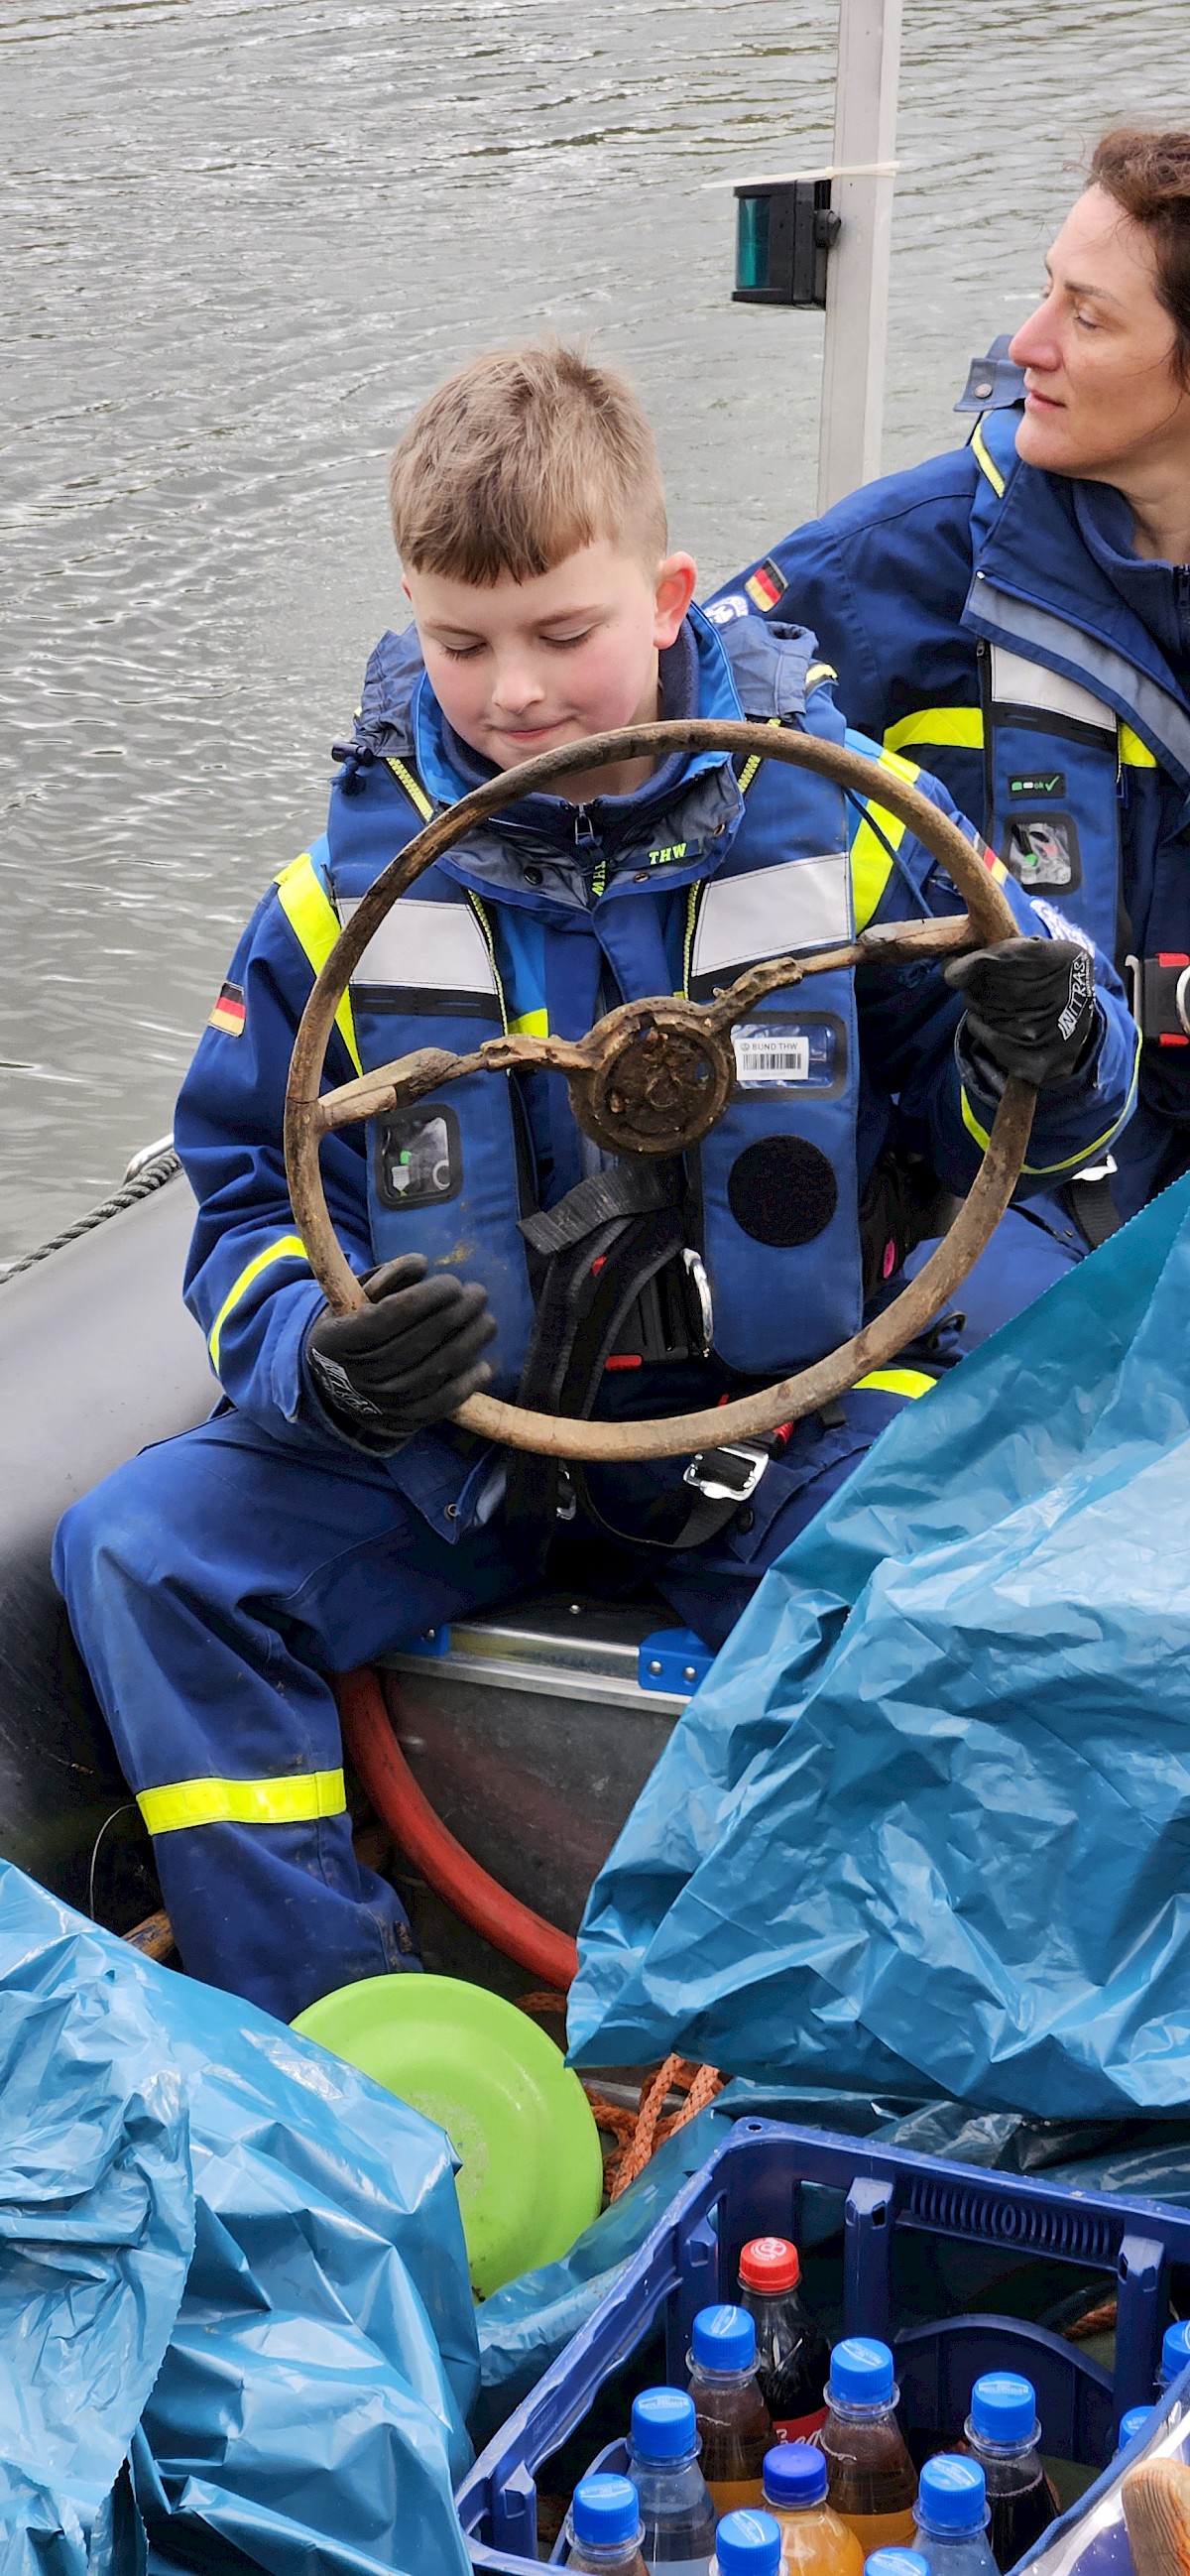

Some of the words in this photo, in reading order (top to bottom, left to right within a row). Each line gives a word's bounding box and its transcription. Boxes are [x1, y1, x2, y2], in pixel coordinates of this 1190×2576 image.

[649, 842, 687, 865] THW
[1058, 958, 1087, 1036] NITRAS
[752, 1043, 776, 1051] BUND
[778, 1043, 798, 1051] THW
